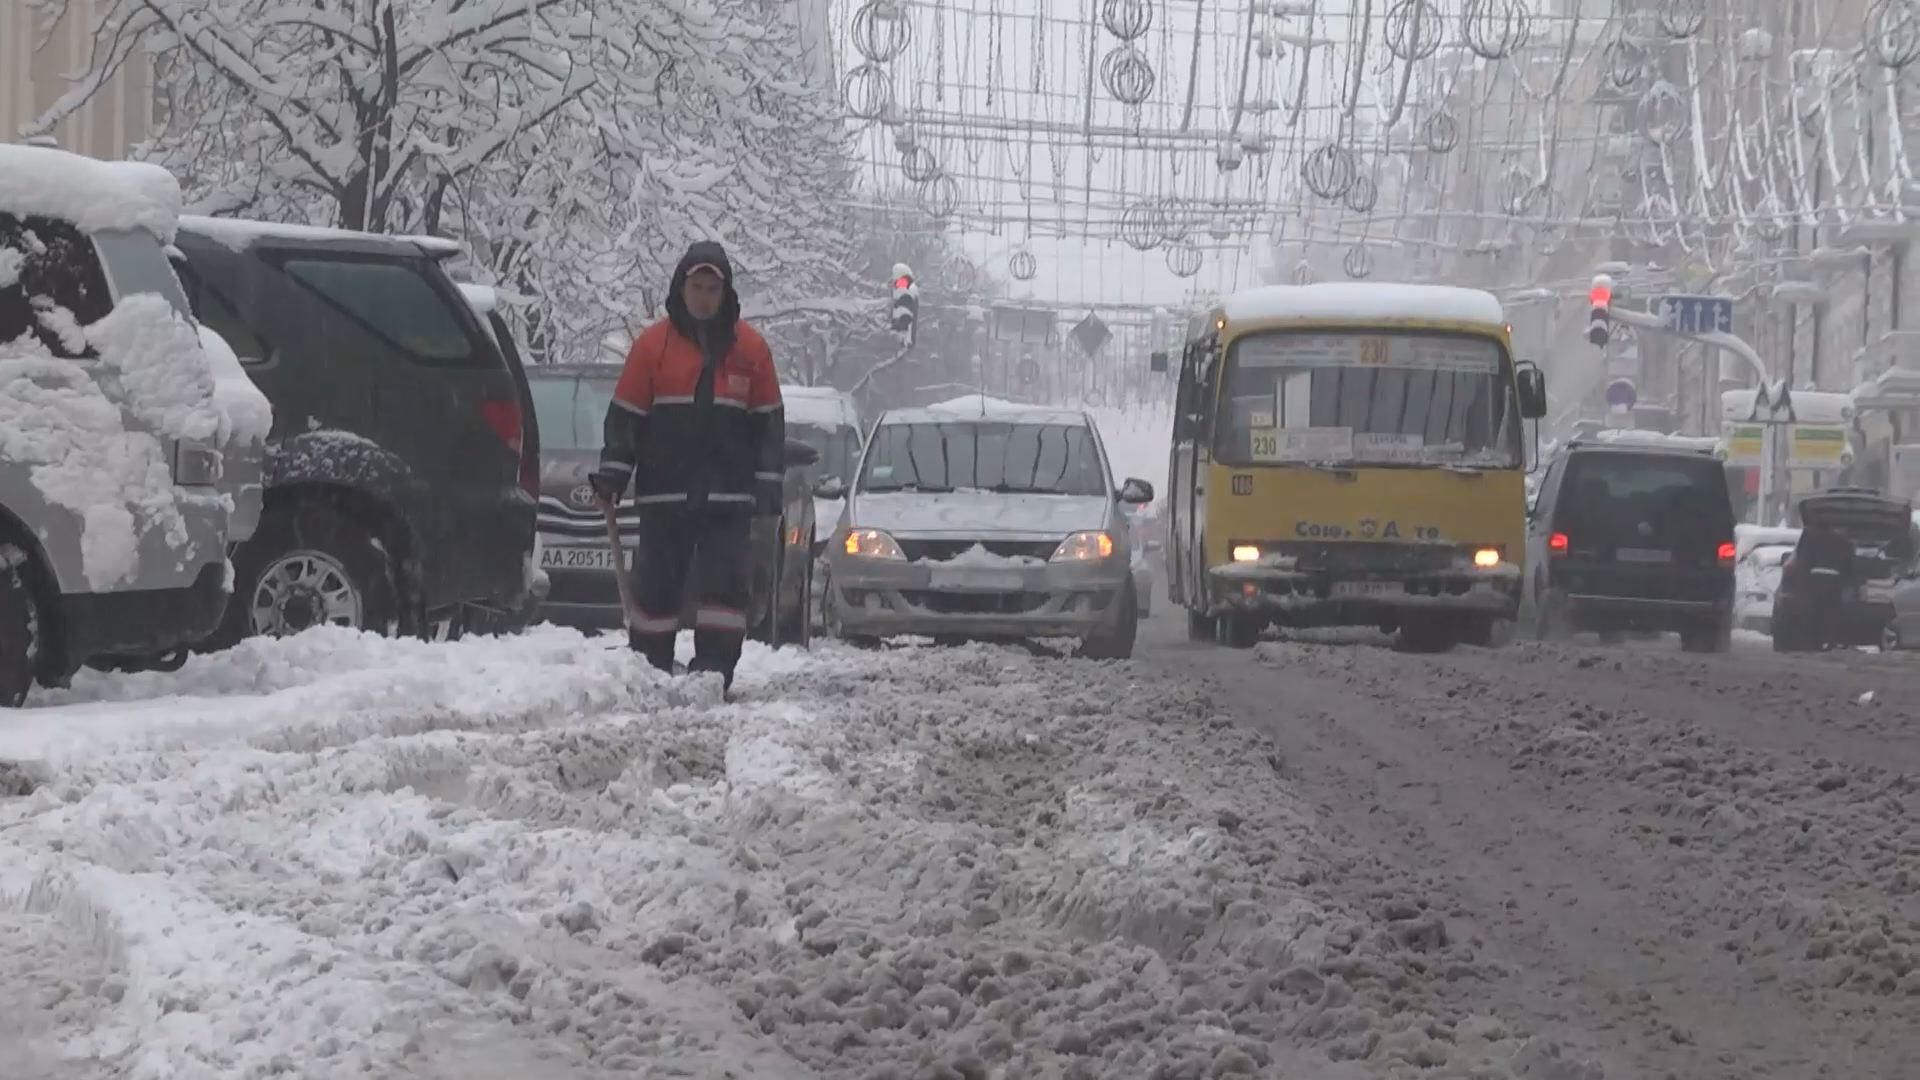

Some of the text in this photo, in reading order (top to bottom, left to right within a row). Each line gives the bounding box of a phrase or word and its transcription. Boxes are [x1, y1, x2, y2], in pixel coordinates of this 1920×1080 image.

[1360, 339, 1388, 364] 230
[1253, 437, 1277, 456] 230
[541, 550, 563, 566] AA
[567, 551, 603, 566] 2051
